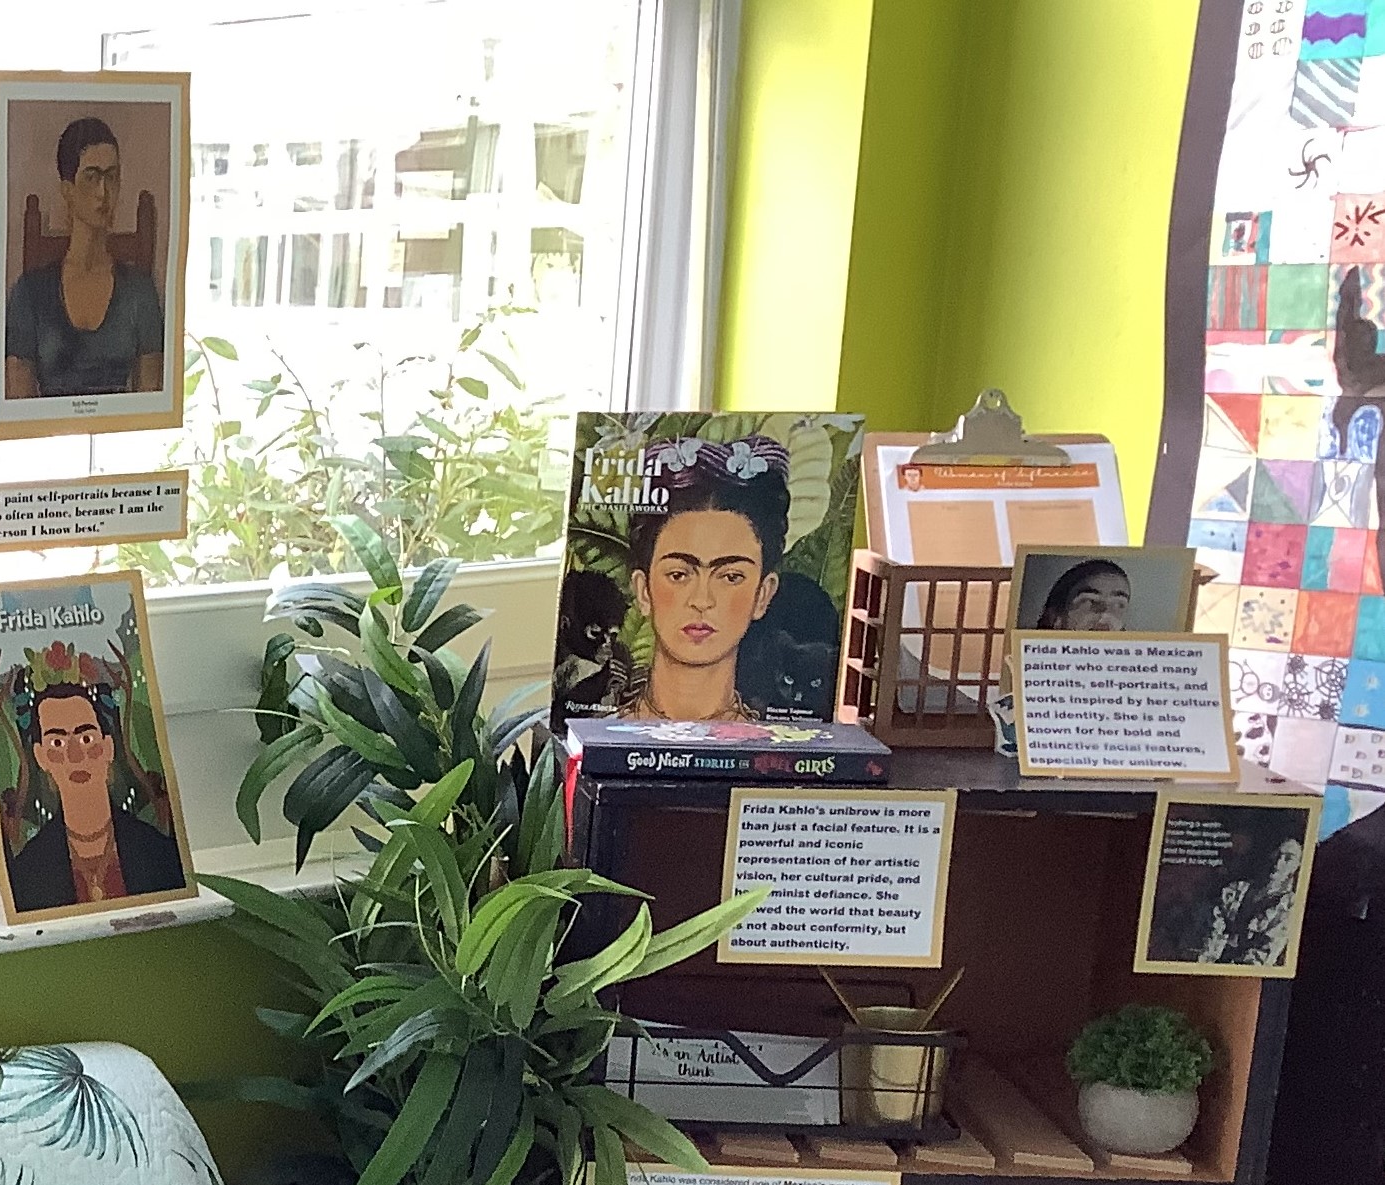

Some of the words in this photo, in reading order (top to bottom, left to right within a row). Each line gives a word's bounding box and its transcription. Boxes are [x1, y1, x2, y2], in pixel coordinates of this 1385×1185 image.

[584, 448, 662, 476] Frida
[4, 493, 33, 507] paint
[37, 489, 109, 506] self-portraits
[111, 488, 153, 499] because
[164, 487, 180, 496] am
[582, 476, 670, 505] Kahlo
[5, 509, 33, 521] often
[75, 506, 116, 518] because
[127, 504, 144, 514] am
[147, 502, 164, 513] the
[40, 525, 71, 536] know
[50, 603, 103, 627] Kahlo
[1024, 644, 1057, 655] Frida
[1061, 645, 1100, 655] Kahlo
[1104, 647, 1131, 656] was
[1147, 647, 1203, 657] Mexican
[1024, 662, 1071, 672] painter
[1075, 663, 1103, 671] who
[1107, 664, 1158, 673] created
[1162, 665, 1198, 676] many
[1024, 679, 1086, 689] portraits,
[1090, 680, 1180, 691] self-portraits,
[1184, 682, 1208, 691] and
[1025, 695, 1066, 704] works
[1070, 695, 1123, 706] inspired
[1127, 696, 1143, 707] by
[1147, 697, 1168, 706] her
[1172, 698, 1220, 708] culture
[1026, 711, 1050, 719] and
[1054, 711, 1110, 722] identity.
[1113, 712, 1138, 721] She
[1158, 713, 1186, 722] also
[1027, 726, 1071, 735] known
[1076, 726, 1094, 735] for
[1097, 727, 1119, 736] her
[1123, 728, 1152, 737] bold
[1156, 729, 1181, 738] and
[1028, 741, 1100, 751] distinctive
[1104, 743, 1141, 752] facial
[1145, 744, 1206, 755] features,
[694, 758, 735, 769] STORIES
[794, 756, 835, 776] GIRLS
[1030, 757, 1099, 767] especially
[1103, 758, 1124, 766] her
[1129, 758, 1187, 768] unibrow.
[743, 804, 775, 814] Frida
[778, 805, 825, 815] Kahlo's
[829, 806, 880, 816] unibrow
[898, 809, 931, 817] more
[741, 821, 769, 831] than
[772, 822, 797, 833] just
[812, 823, 848, 832] facial
[851, 823, 900, 833] feature.
[904, 824, 914, 833] It
[918, 825, 929, 834] is
[739, 838, 795, 849] powerful
[798, 839, 822, 848] and
[825, 839, 864, 849] iconic
[737, 856, 830, 866] representation
[834, 856, 847, 866] of
[850, 857, 872, 866] her
[874, 857, 920, 868] artistic
[736, 870, 777, 882] vision,
[780, 872, 802, 881] her
[804, 873, 854, 882] cultural
[857, 874, 893, 885] pride,
[897, 875, 921, 884] and
[813, 889, 872, 900] defiance.
[876, 891, 900, 900] She
[785, 905, 806, 915] the
[809, 906, 845, 916] world
[849, 906, 874, 917] that
[878, 908, 921, 920] beauty
[746, 922, 767, 930] not
[770, 922, 806, 931] about
[810, 923, 882, 935] conformity,
[885, 924, 906, 934] but
[730, 937, 767, 947] about
[769, 938, 850, 951] authenticity.
[674, 1050, 690, 1061] an
[697, 1048, 740, 1065] Artist
[678, 1063, 714, 1077] think
